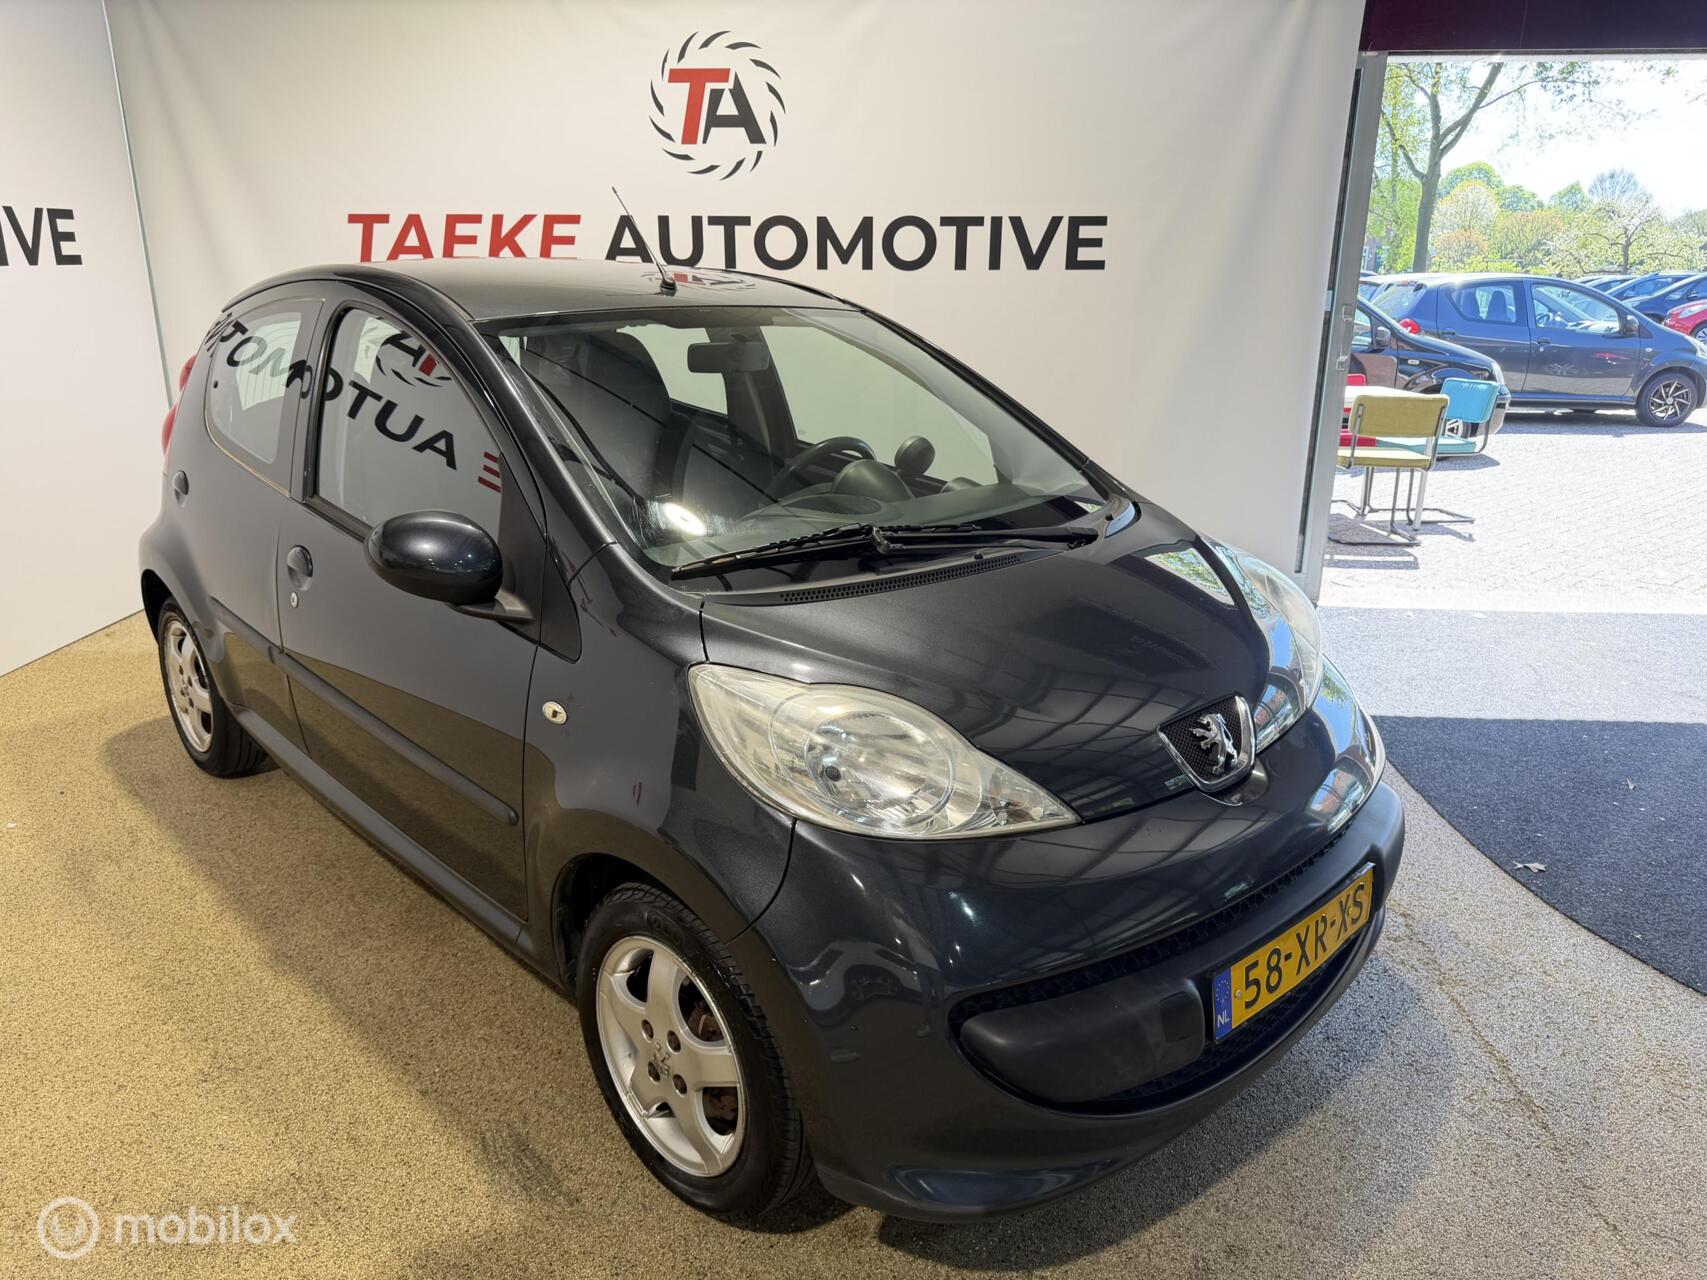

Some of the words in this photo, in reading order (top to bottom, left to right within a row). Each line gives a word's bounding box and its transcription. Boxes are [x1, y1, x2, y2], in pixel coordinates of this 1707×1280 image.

[667, 67, 767, 145] TA
[347, 213, 582, 262] TAEKE
[604, 215, 1108, 270] AUTOMOTIVE
[1244, 883, 1365, 1009] 58-XR-XS
[1217, 1009, 1230, 1028] NL
